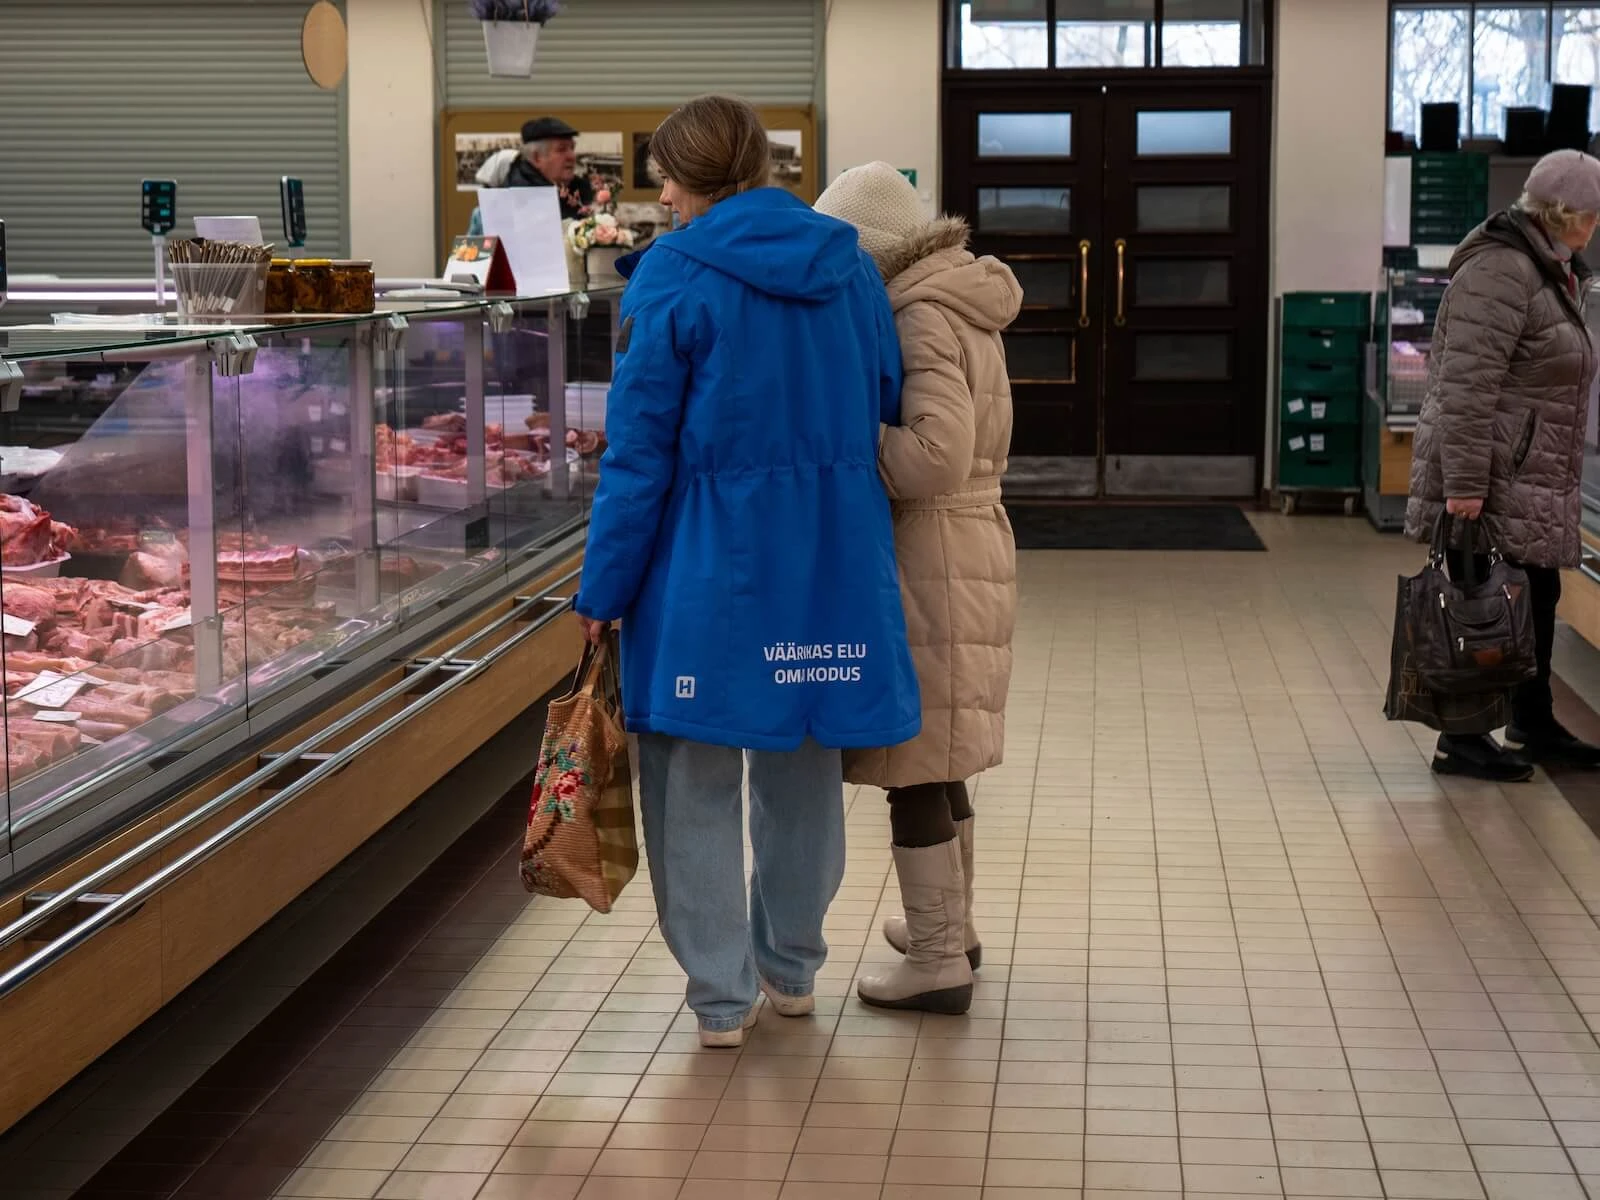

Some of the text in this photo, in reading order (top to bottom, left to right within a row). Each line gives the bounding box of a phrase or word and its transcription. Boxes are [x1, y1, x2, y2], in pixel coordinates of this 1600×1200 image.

[764, 642, 866, 661] VÄÄRIKAS ELU
[807, 667, 861, 682] KODUS
